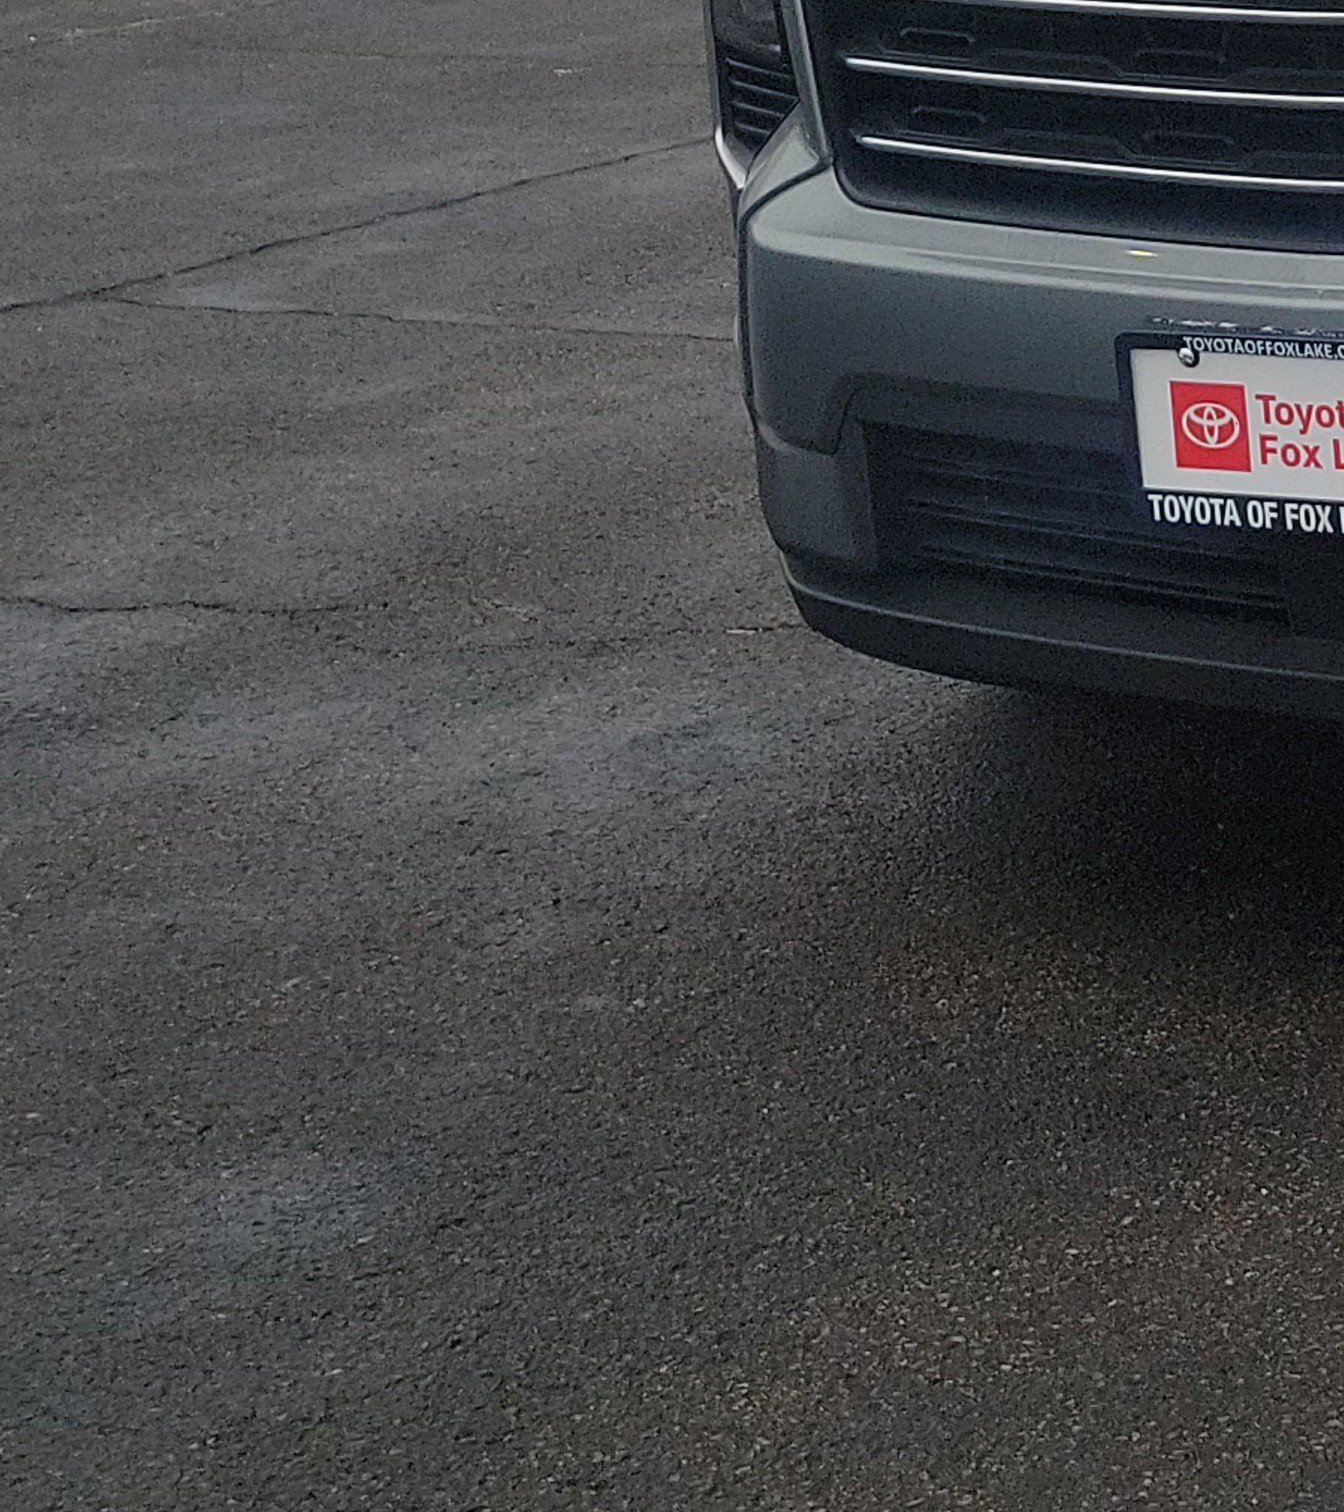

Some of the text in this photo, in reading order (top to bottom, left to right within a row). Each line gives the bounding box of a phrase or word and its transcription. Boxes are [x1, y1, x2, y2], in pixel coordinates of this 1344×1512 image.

[1258, 434, 1323, 469] Fox
[1147, 493, 1242, 529] TOYOTA
[1246, 500, 1281, 530] OF
[1284, 503, 1335, 534] FOX
